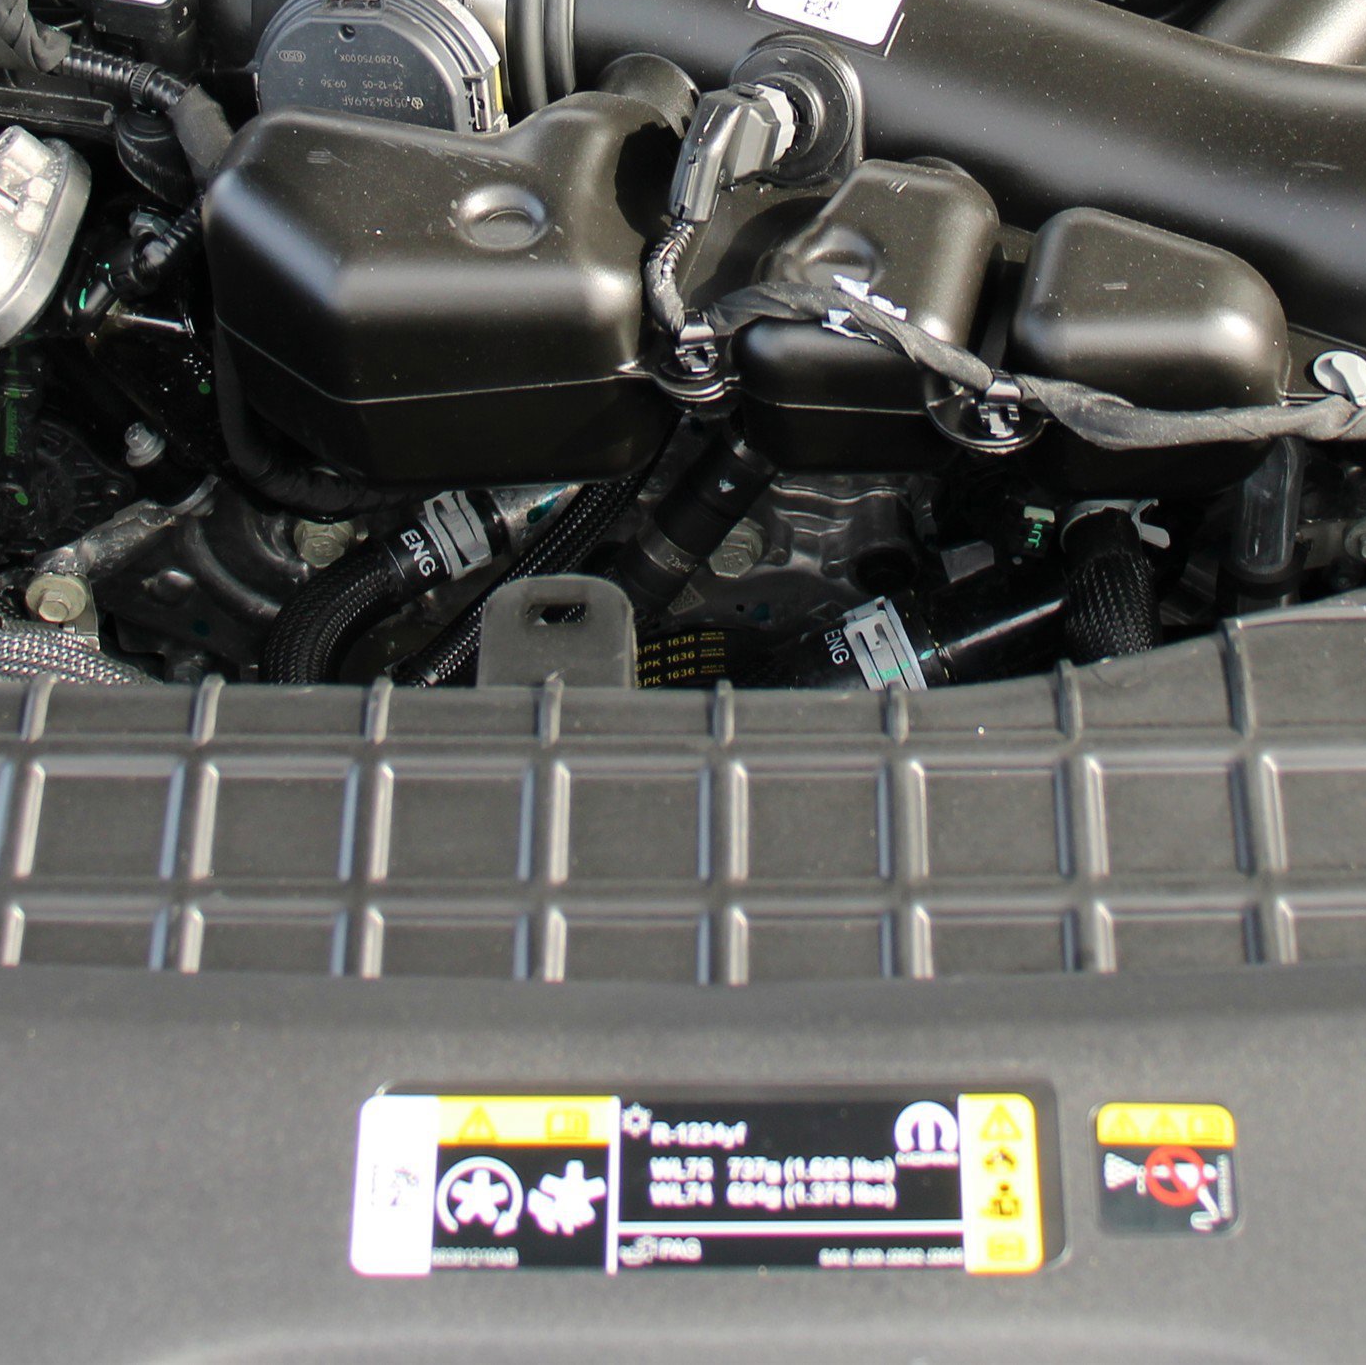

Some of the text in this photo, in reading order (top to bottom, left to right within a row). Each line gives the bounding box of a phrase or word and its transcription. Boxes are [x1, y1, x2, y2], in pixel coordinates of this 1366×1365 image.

[400, 529, 436, 577] ENG
[667, 634, 695, 647] 1636
[824, 628, 850, 665] ENG
[667, 651, 695, 664] 1636
[667, 667, 695, 680] 1636
